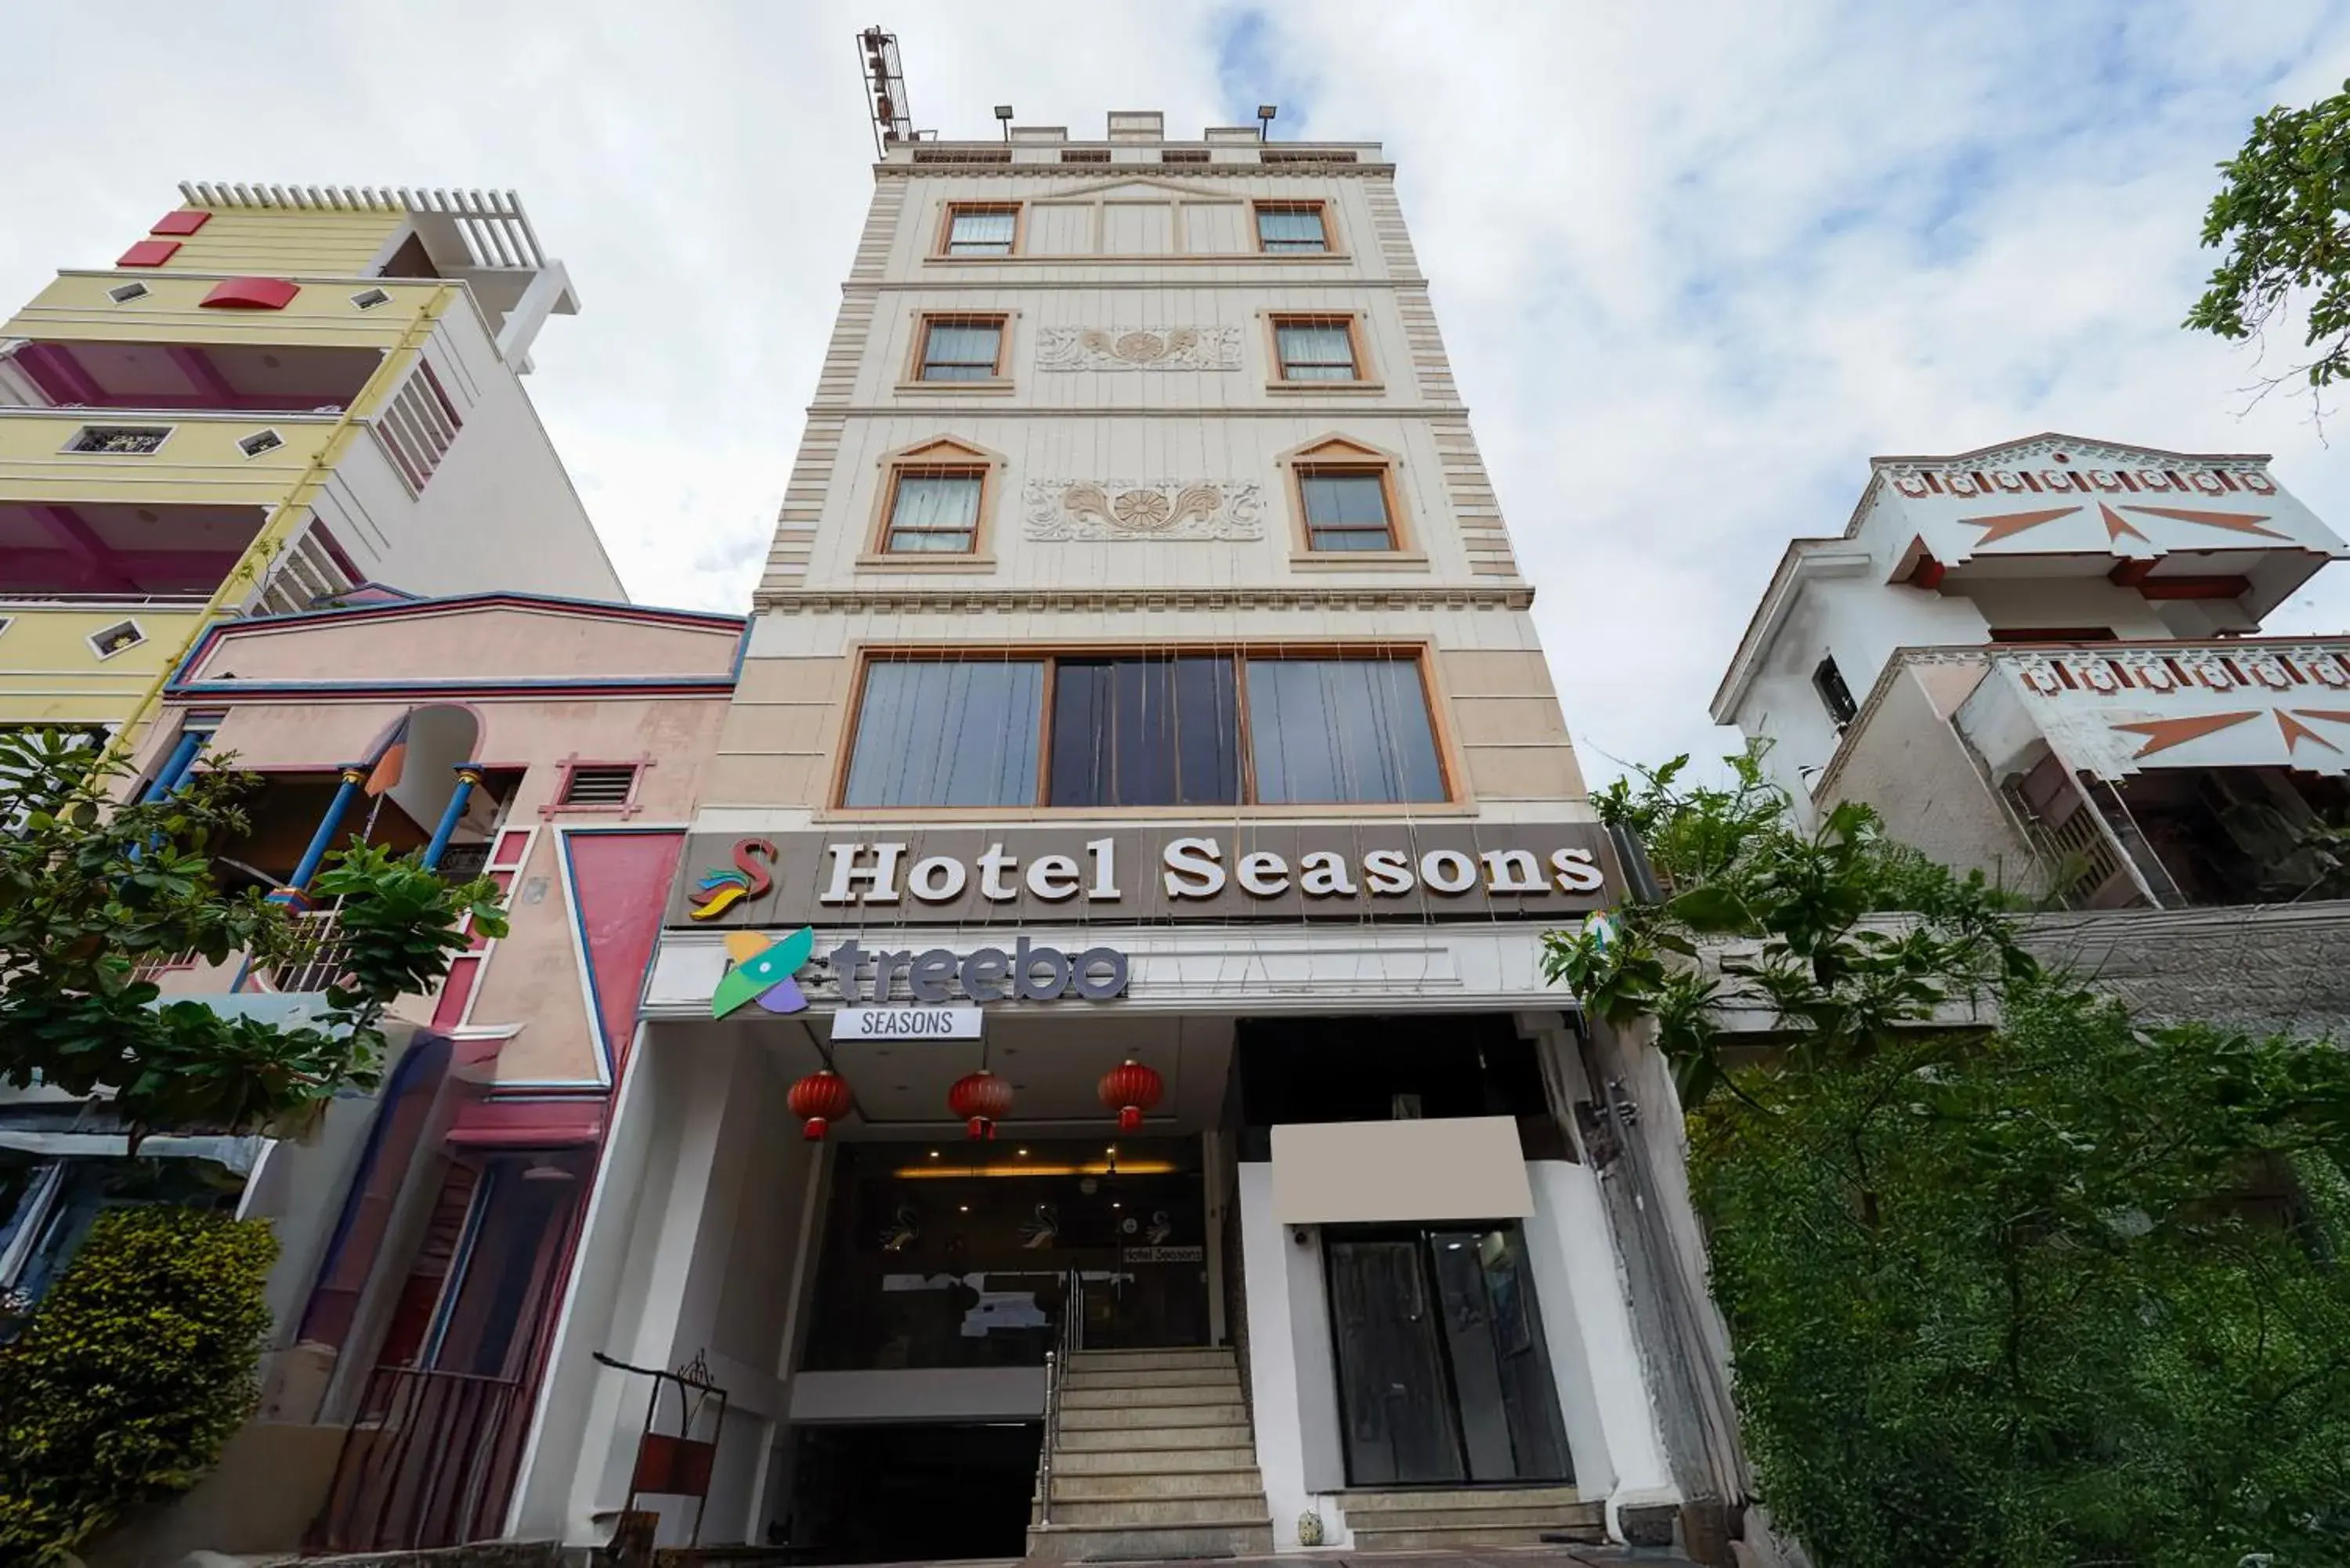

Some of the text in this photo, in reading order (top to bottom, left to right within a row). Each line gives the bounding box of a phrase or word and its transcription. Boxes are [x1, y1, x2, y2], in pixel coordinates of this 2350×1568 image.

[819, 837, 1604, 905] Hotel Seasons
[830, 936, 1128, 1003] treebo
[861, 1011, 953, 1035] SEASONS
